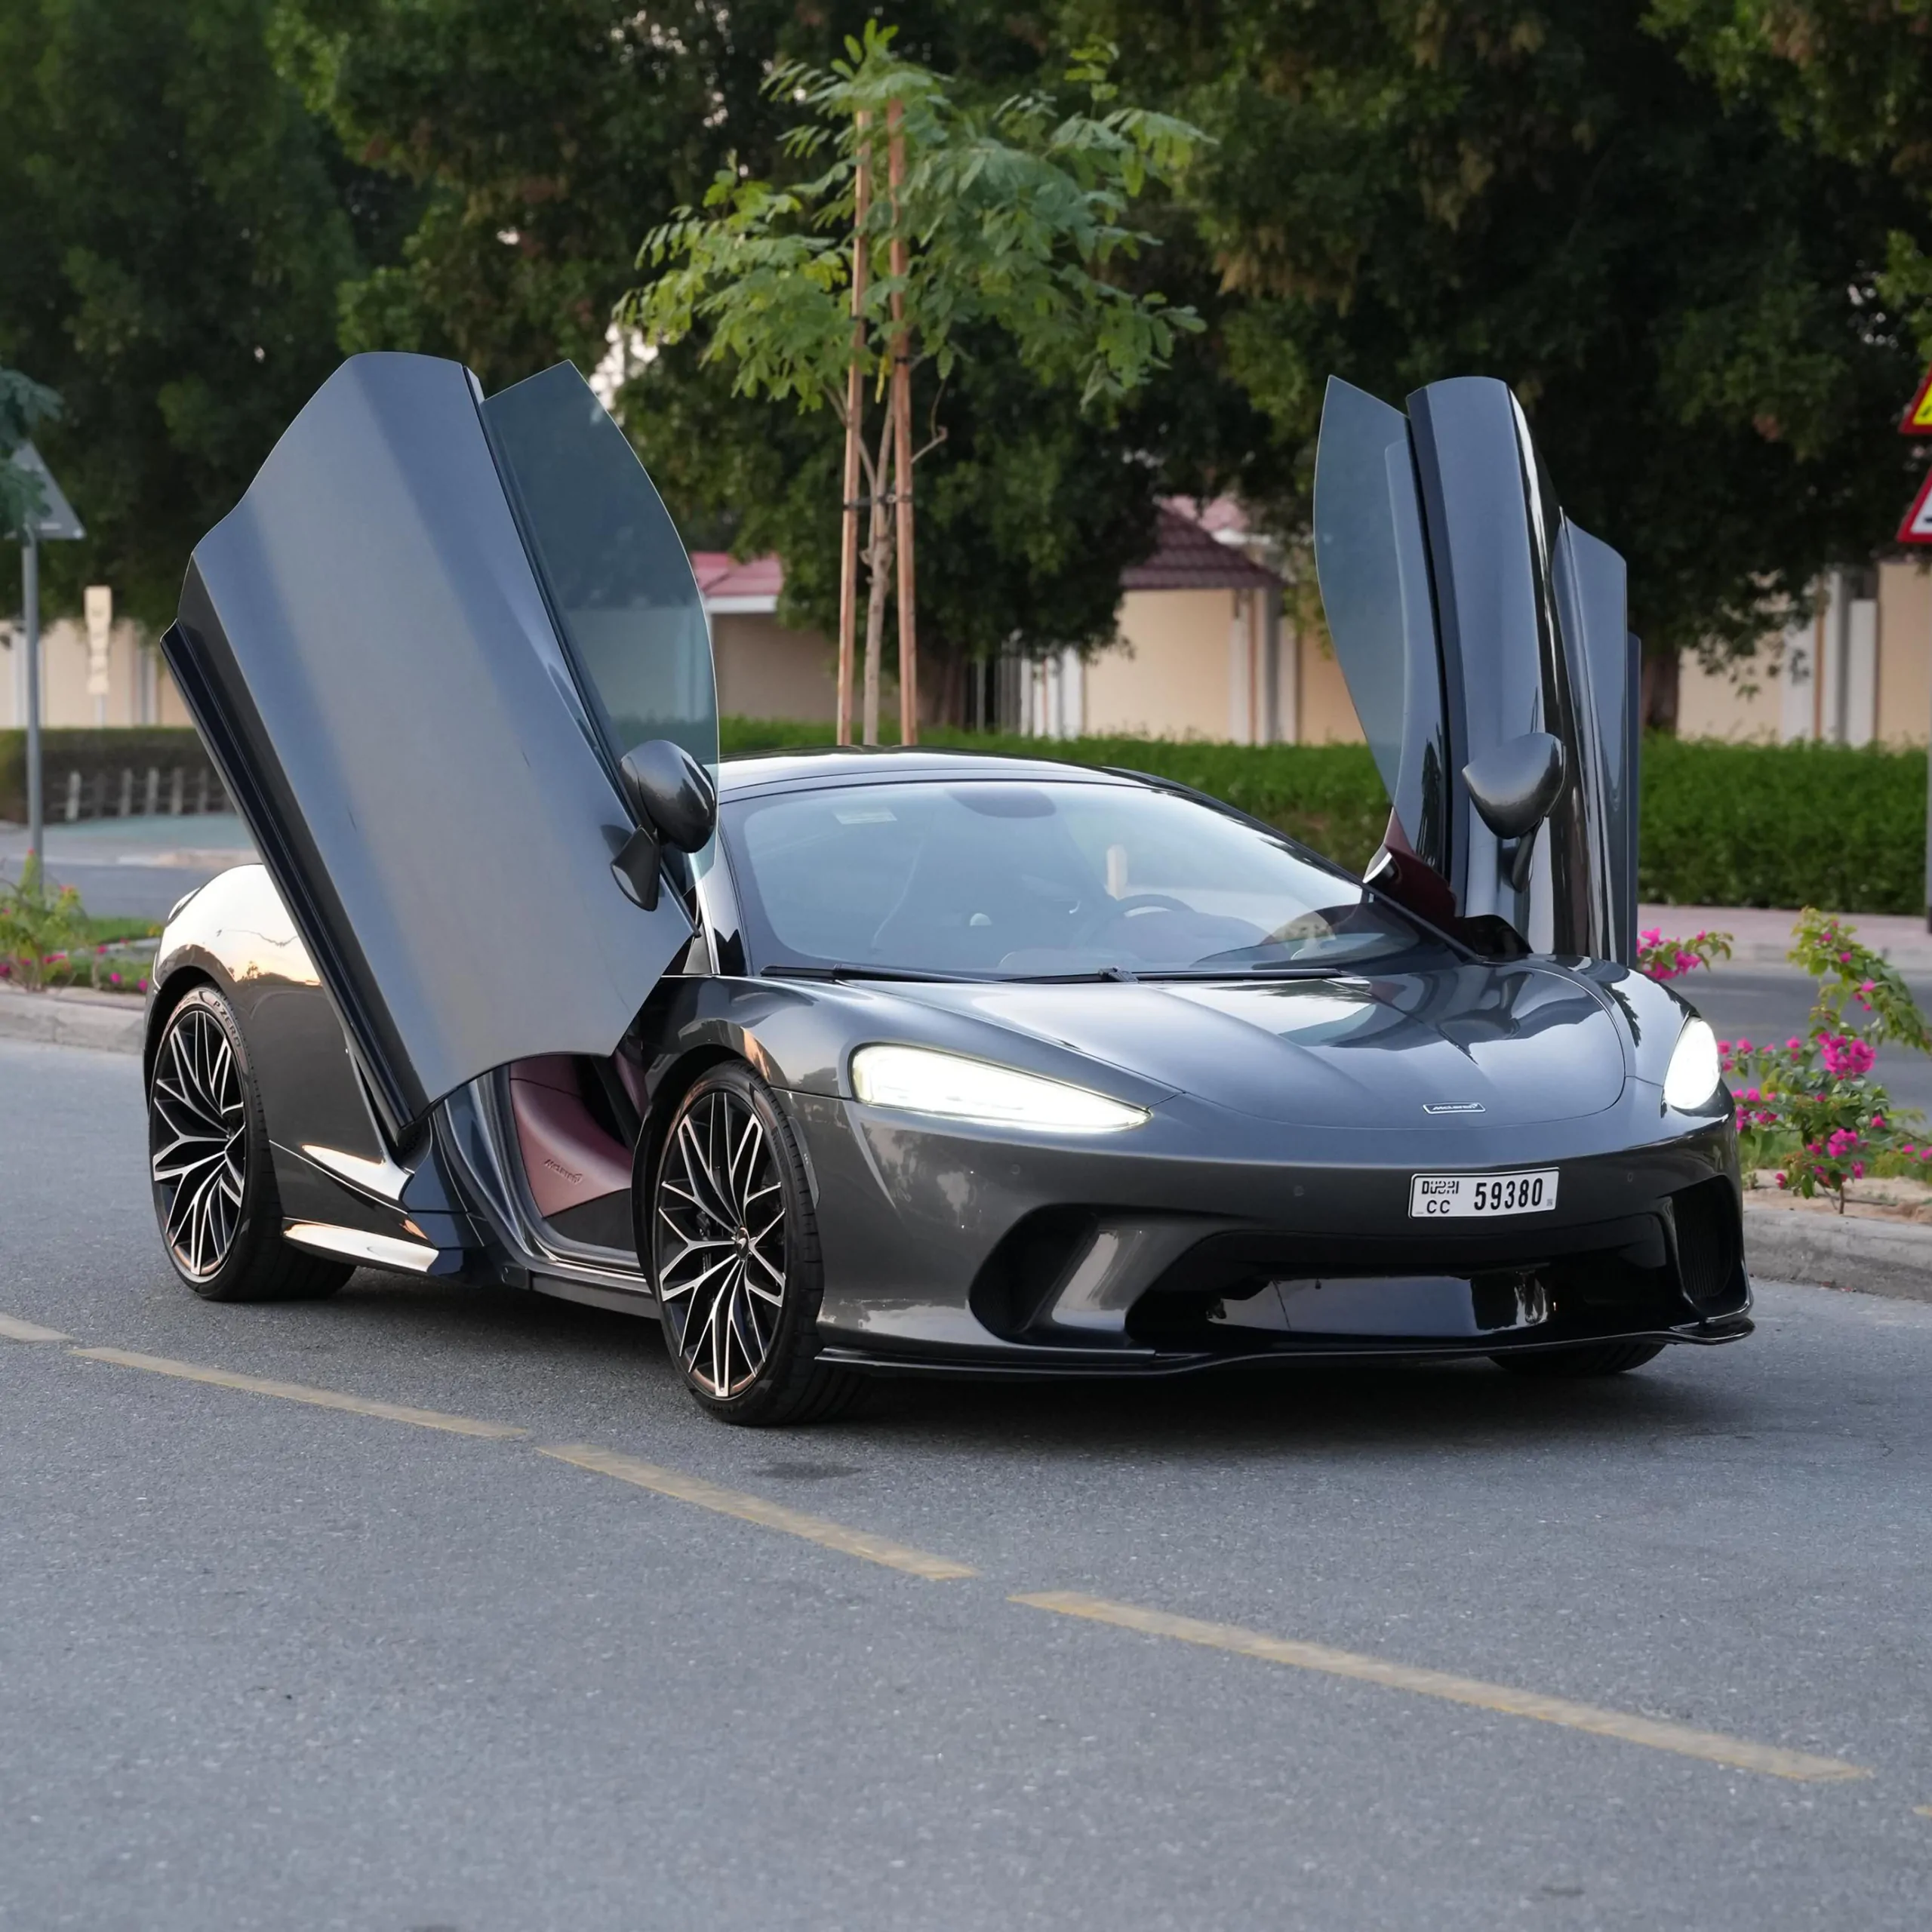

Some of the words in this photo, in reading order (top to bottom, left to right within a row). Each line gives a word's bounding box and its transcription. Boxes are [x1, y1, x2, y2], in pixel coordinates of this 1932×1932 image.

[220, 1008, 241, 1047] ZERO
[1422, 1180, 1460, 1194] DUBAI
[1474, 1178, 1543, 1211] 59380
[1426, 1200, 1451, 1214] CC
